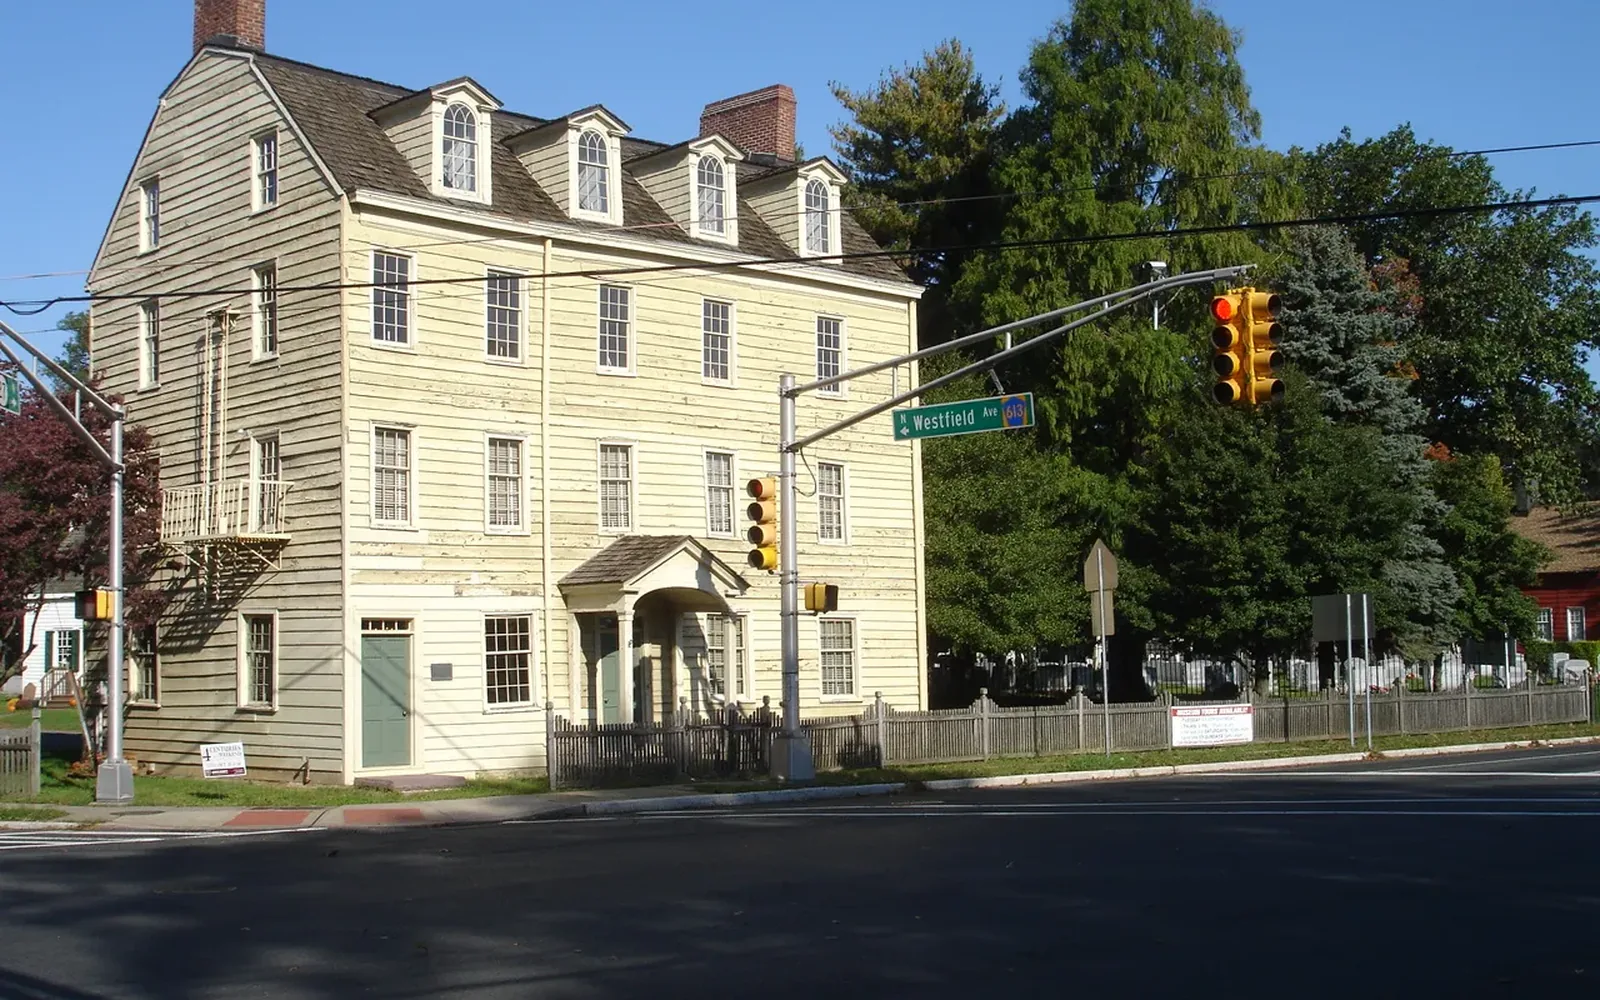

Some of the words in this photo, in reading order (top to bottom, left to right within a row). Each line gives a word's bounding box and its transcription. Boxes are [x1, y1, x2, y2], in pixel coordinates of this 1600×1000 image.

[900, 413, 907, 424] N
[913, 409, 975, 431] Westfield
[983, 406, 998, 418] Ave
[1006, 404, 1024, 419] 613
